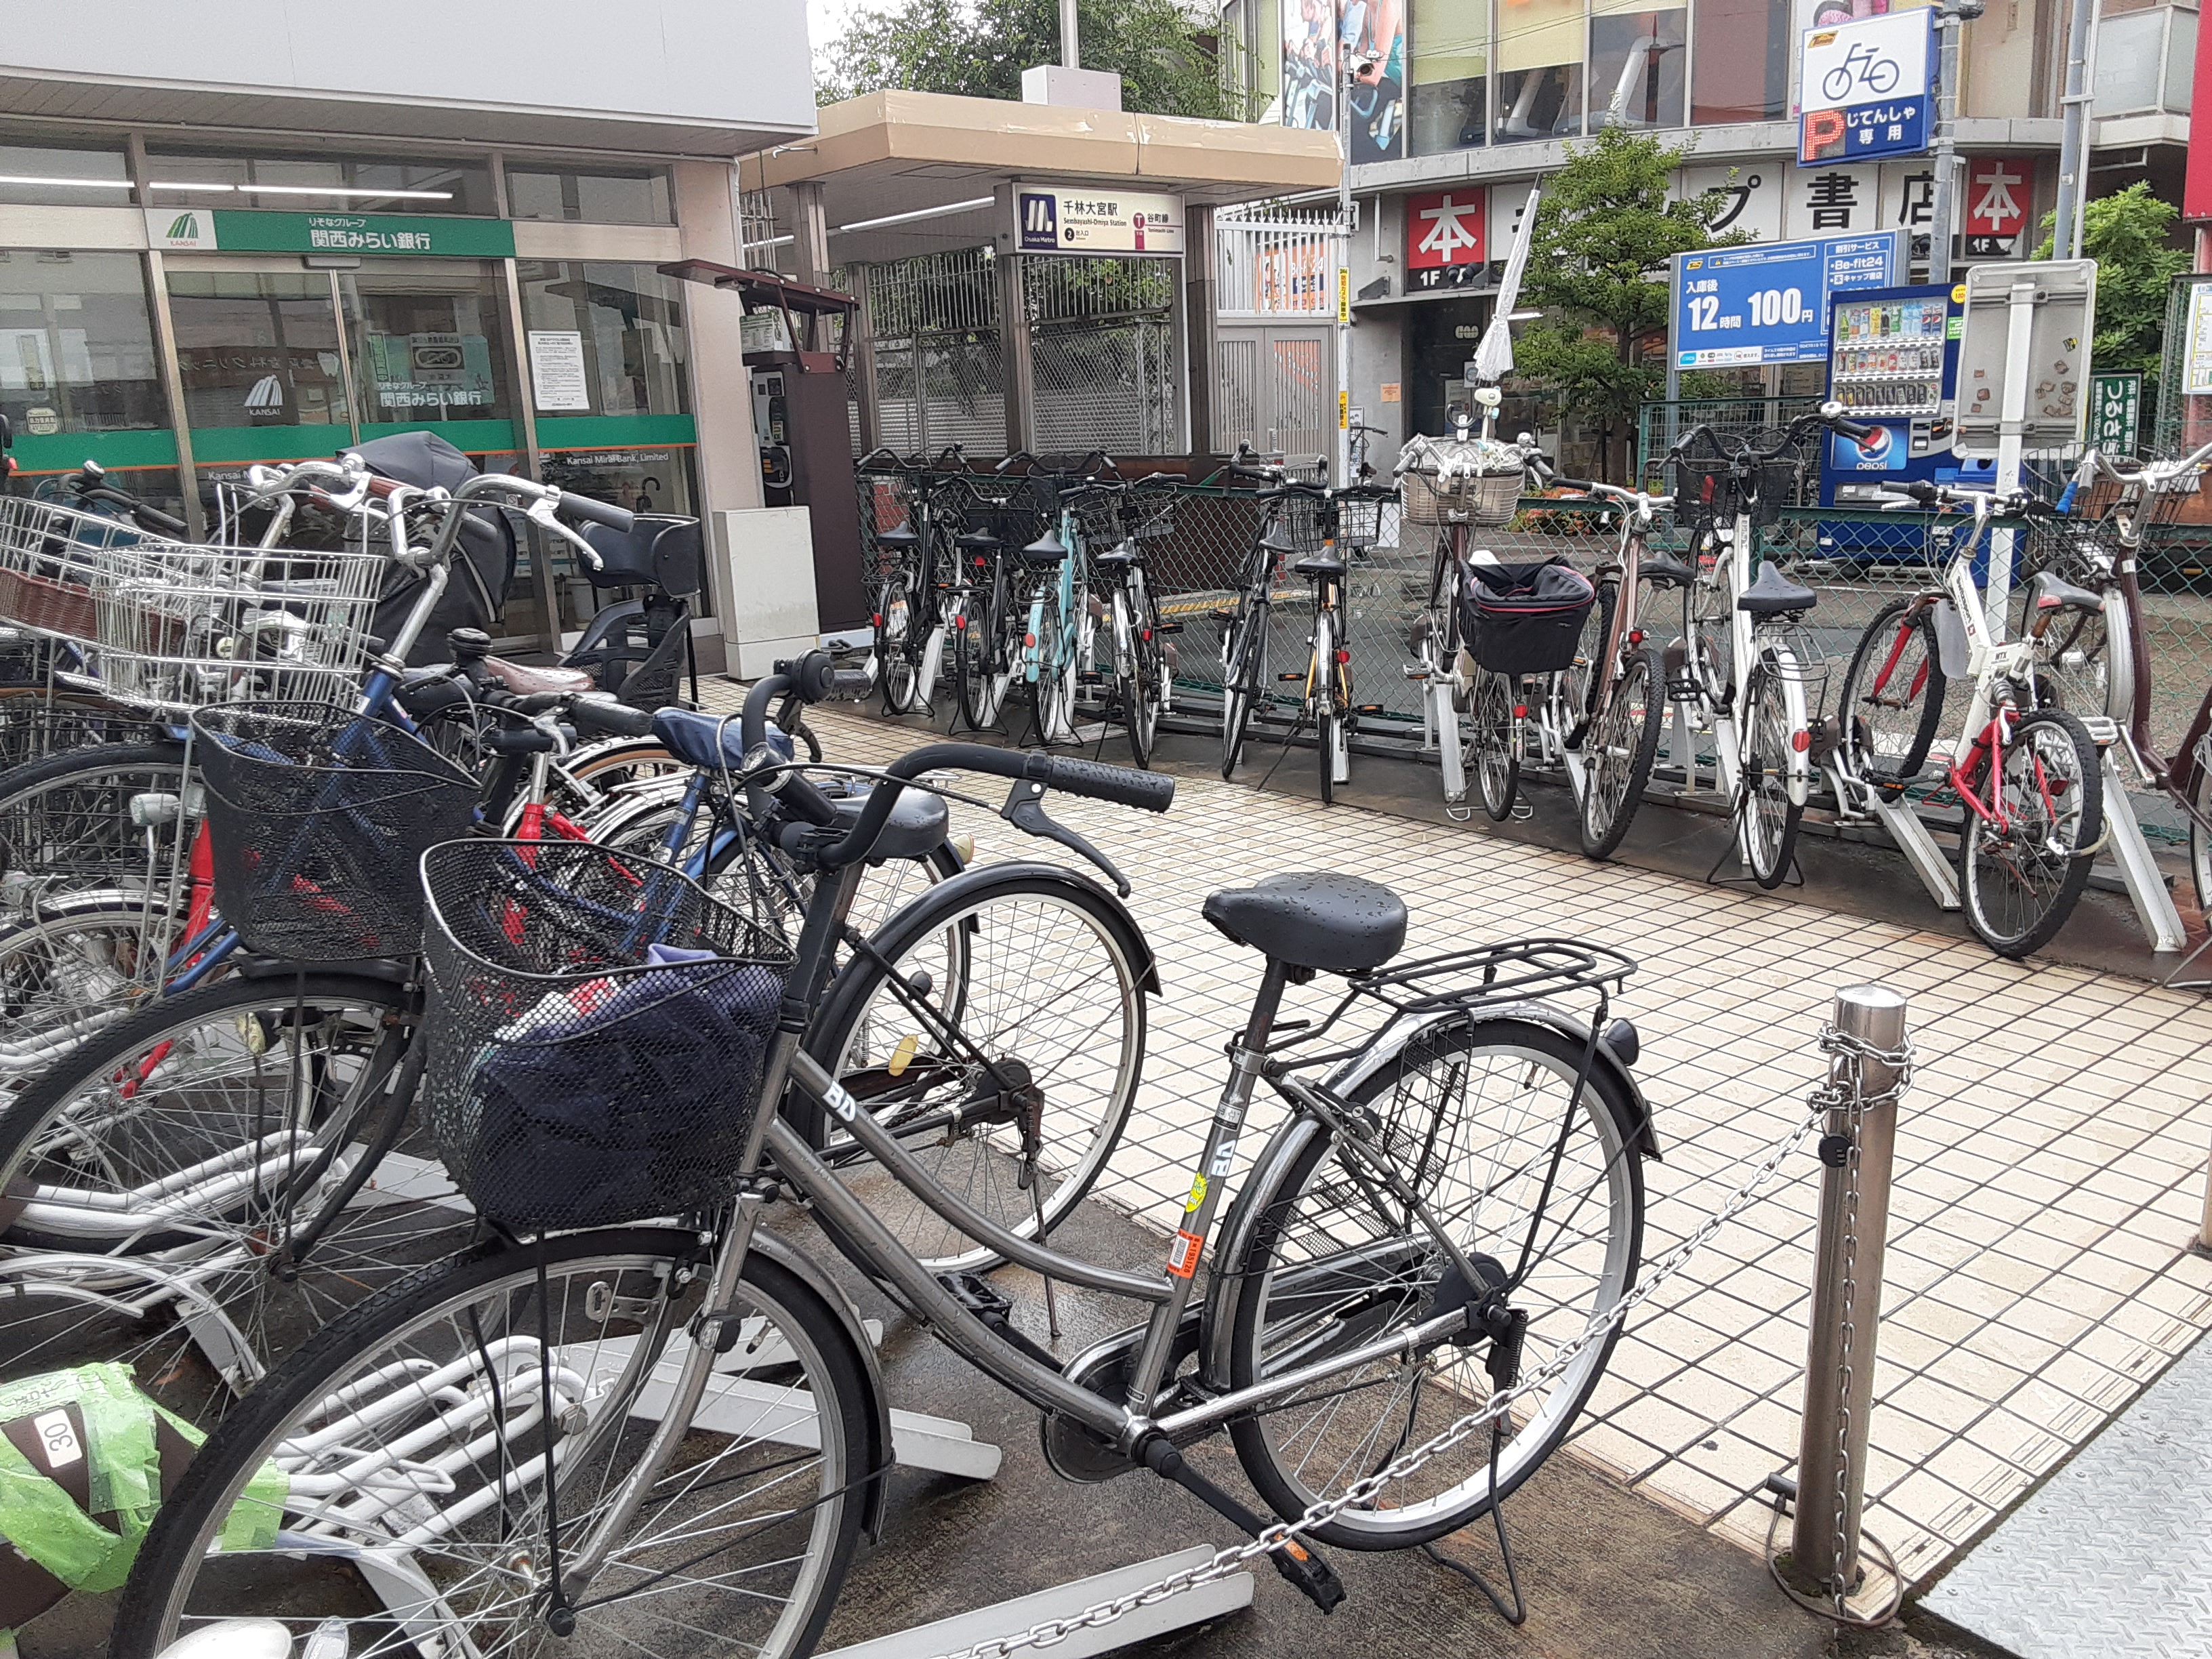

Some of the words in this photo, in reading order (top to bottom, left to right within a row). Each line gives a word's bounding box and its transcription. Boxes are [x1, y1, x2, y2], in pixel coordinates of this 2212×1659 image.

[1847, 106, 1916, 127] じてんしゃ
[1805, 110, 1845, 161] P
[1973, 161, 2022, 231] 本
[1063, 200, 1118, 217] 千林大宮駅
[308, 217, 367, 228] りそなグループ
[1418, 194, 1477, 263] 本
[310, 229, 432, 250] 関西みらい銀行
[1835, 241, 1880, 254] 割引サービス
[1971, 238, 1990, 253] 1F
[1835, 255, 1884, 270] Be-fit24
[1420, 267, 1441, 287] 1F
[1685, 279, 1719, 294] 入庫後
[380, 390, 483, 407] 関西みらい銀行
[249, 407, 282, 416] KANSAI
[565, 456, 593, 466] Kansai
[208, 470, 243, 481] Kansai
[44, 1422, 73, 1452] 30
